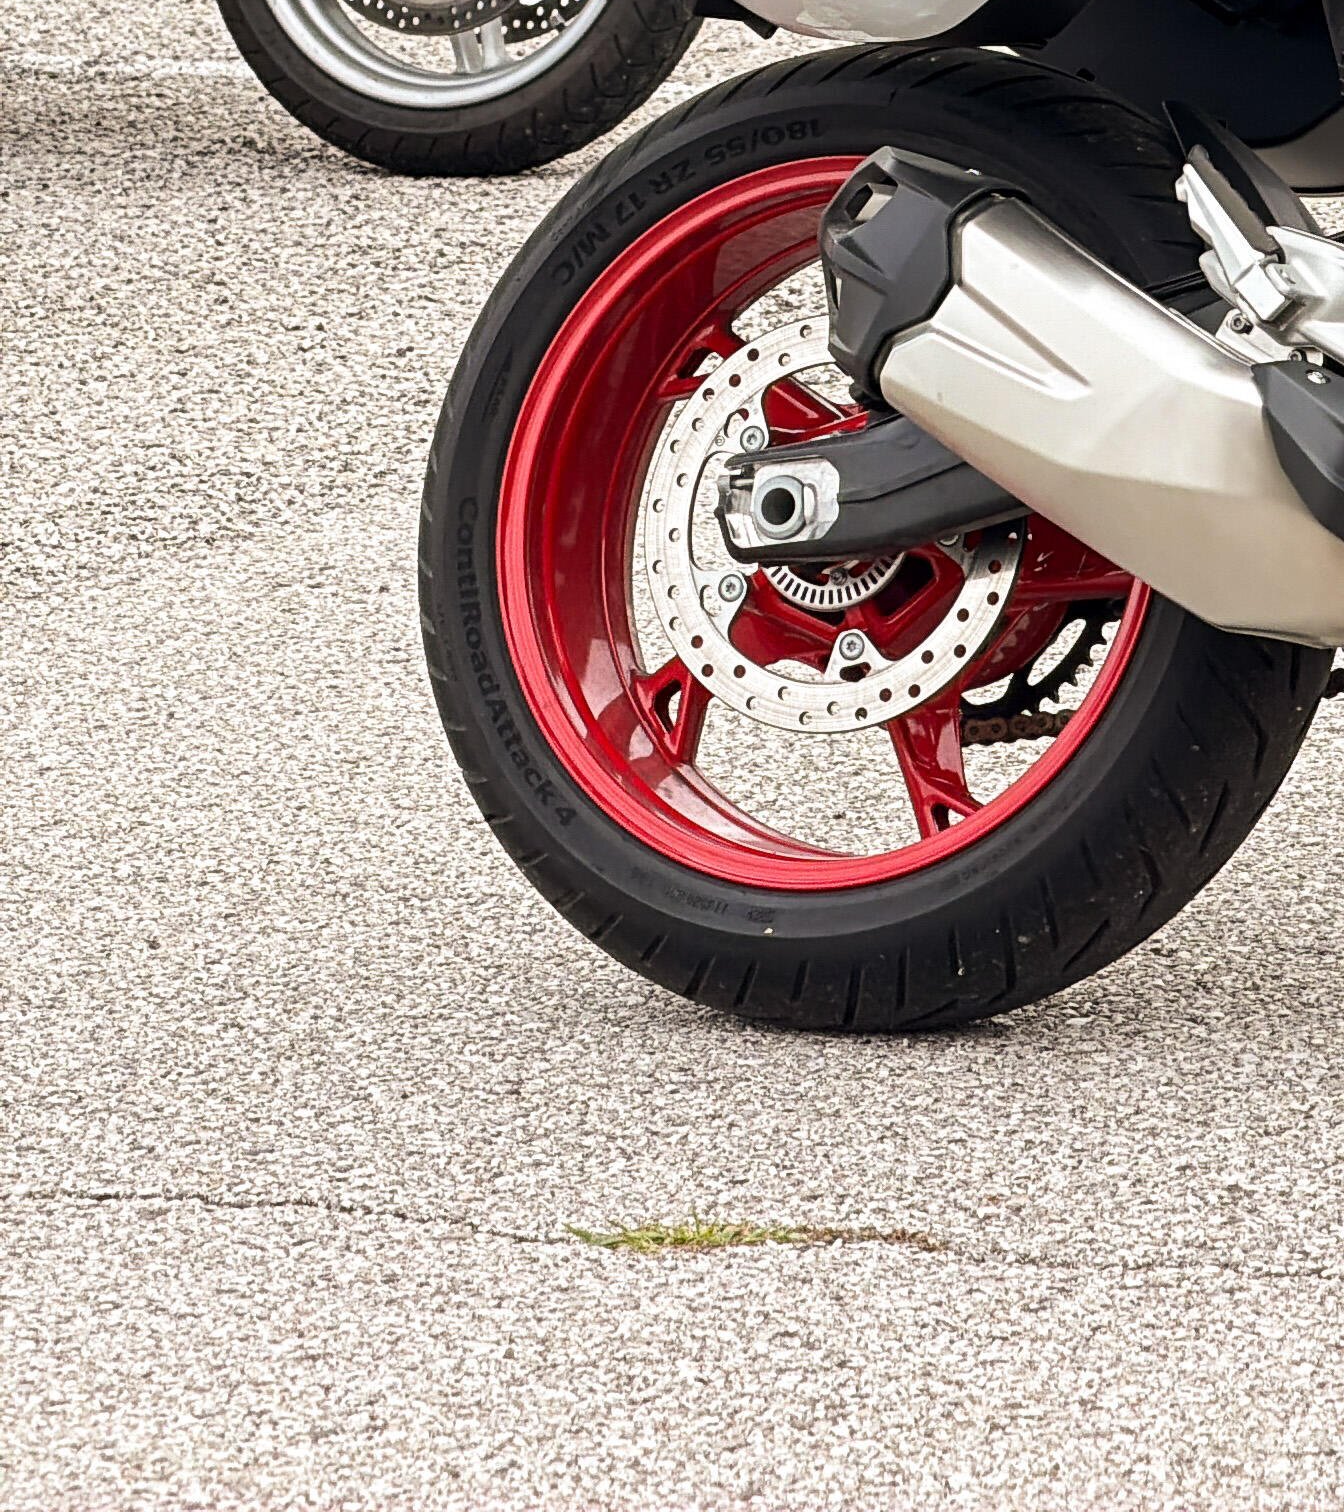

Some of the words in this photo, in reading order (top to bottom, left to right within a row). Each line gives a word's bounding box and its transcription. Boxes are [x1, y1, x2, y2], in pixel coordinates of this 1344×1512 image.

[704, 117, 829, 167] 180/55
[648, 159, 697, 195] ZR
[614, 191, 647, 227] 17
[456, 495, 555, 806] ContiRoadAttack
